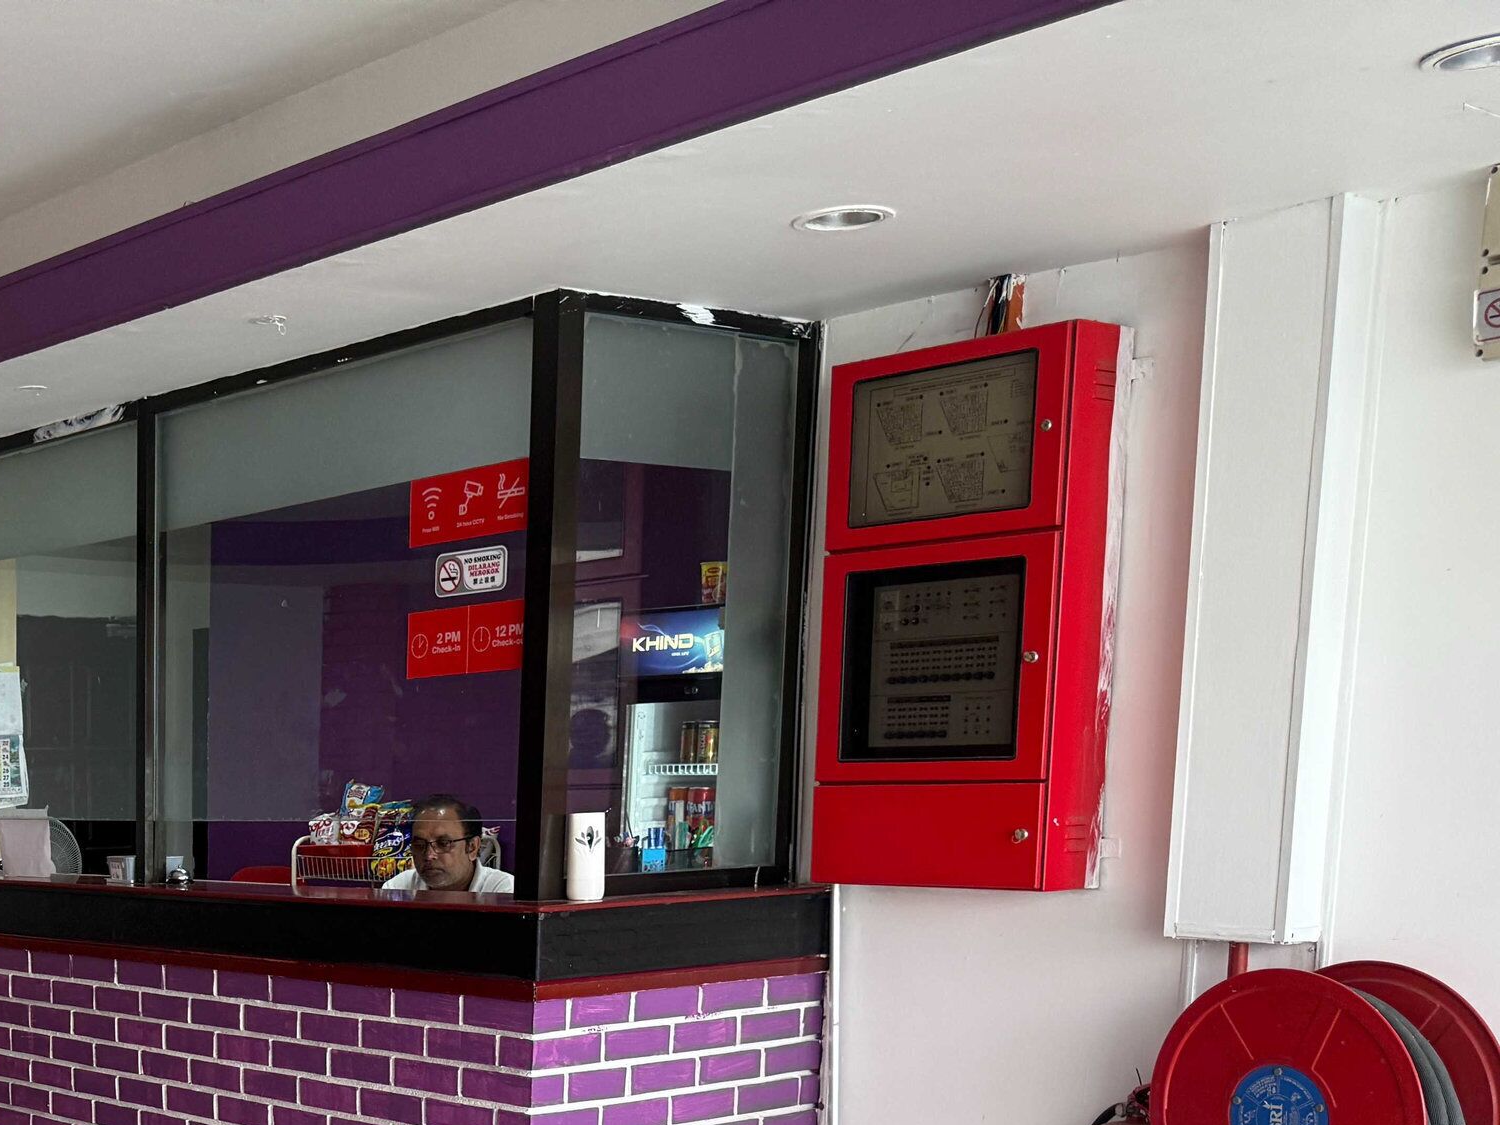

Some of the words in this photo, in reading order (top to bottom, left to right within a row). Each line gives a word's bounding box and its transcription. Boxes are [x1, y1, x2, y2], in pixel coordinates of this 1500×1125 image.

[472, 517, 485, 526] CCTV
[474, 554, 502, 563] SMOKING
[468, 561, 501, 571] DILARANG
[469, 567, 500, 577] MEROKOK
[495, 624, 507, 638] 12
[508, 623, 524, 636] PM
[436, 633, 444, 644] 2
[444, 631, 461, 643] PM
[632, 633, 694, 652] KHIND
[431, 643, 461, 654] Check-in
